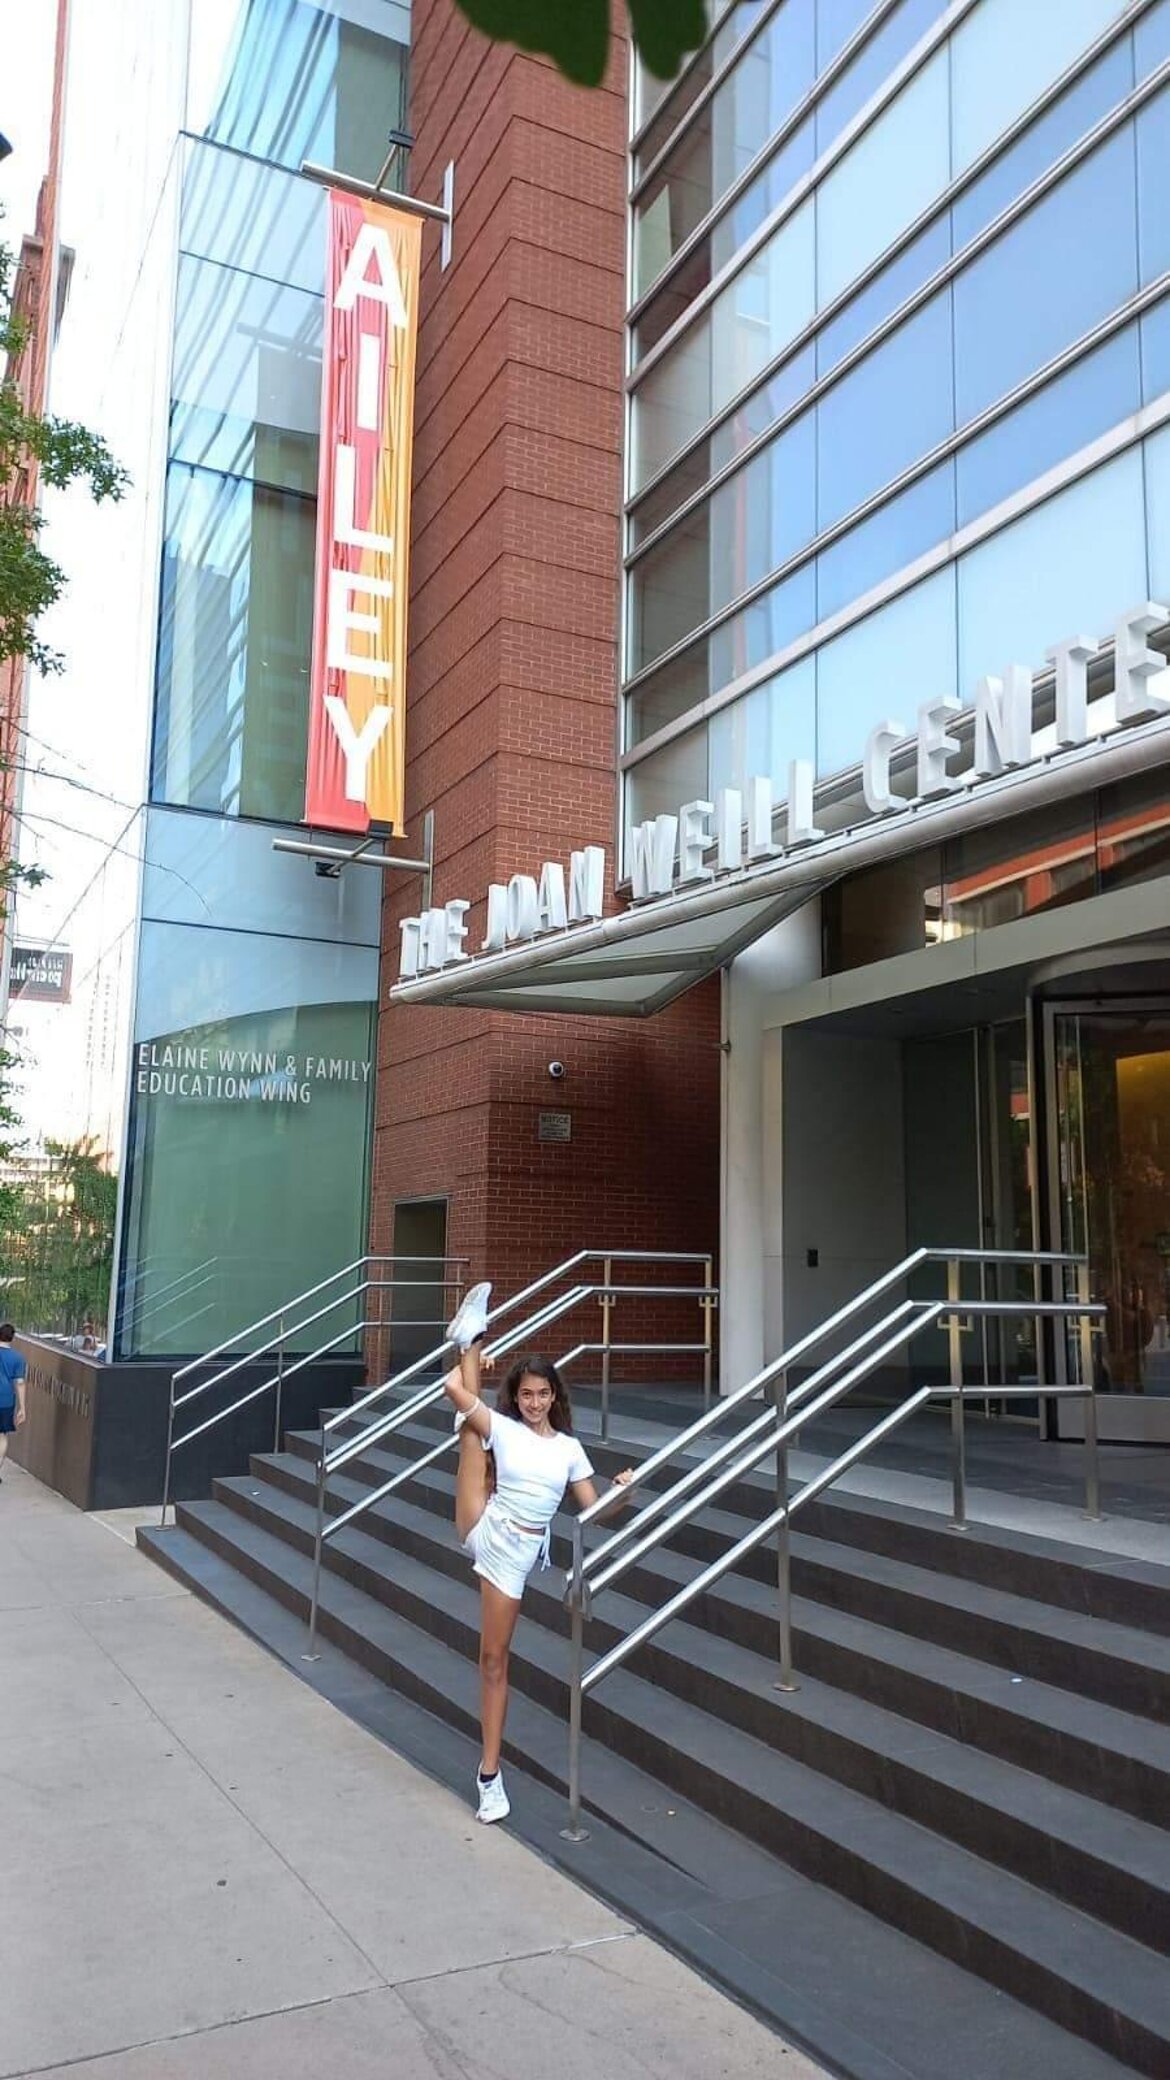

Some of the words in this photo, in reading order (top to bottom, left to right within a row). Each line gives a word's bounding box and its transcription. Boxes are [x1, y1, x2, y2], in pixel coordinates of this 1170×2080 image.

[323, 222, 408, 803] AILEY
[399, 899, 470, 976] THE
[481, 845, 605, 950] JOAN
[630, 758, 826, 899] WEILL
[137, 1071, 251, 1100] EDUCATION
[260, 1081, 312, 1104] WING
[138, 1043, 209, 1070] ELAINE
[219, 1050, 277, 1075] WYNN
[285, 1055, 298, 1077] &
[305, 1056, 372, 1083] FAMILY
